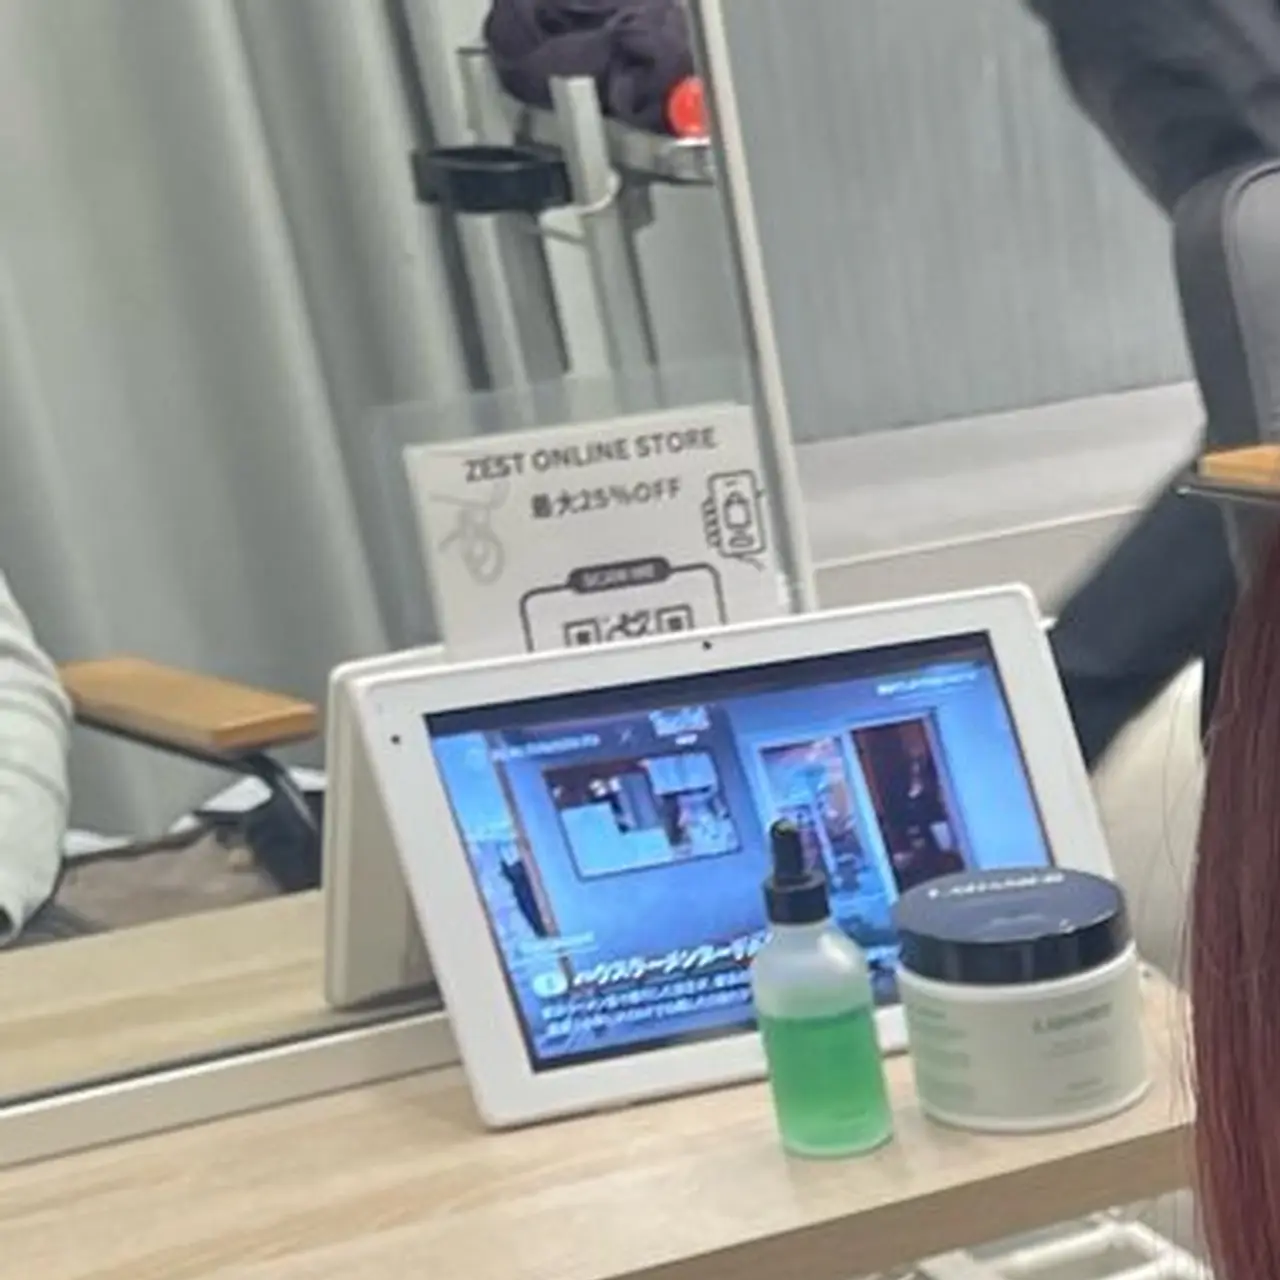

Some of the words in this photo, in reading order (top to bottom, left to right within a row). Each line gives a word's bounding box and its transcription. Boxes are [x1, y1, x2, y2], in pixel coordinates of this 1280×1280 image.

[466, 453, 524, 482] ZEST
[531, 439, 630, 471] ONLINE
[635, 428, 717, 458] STORE
